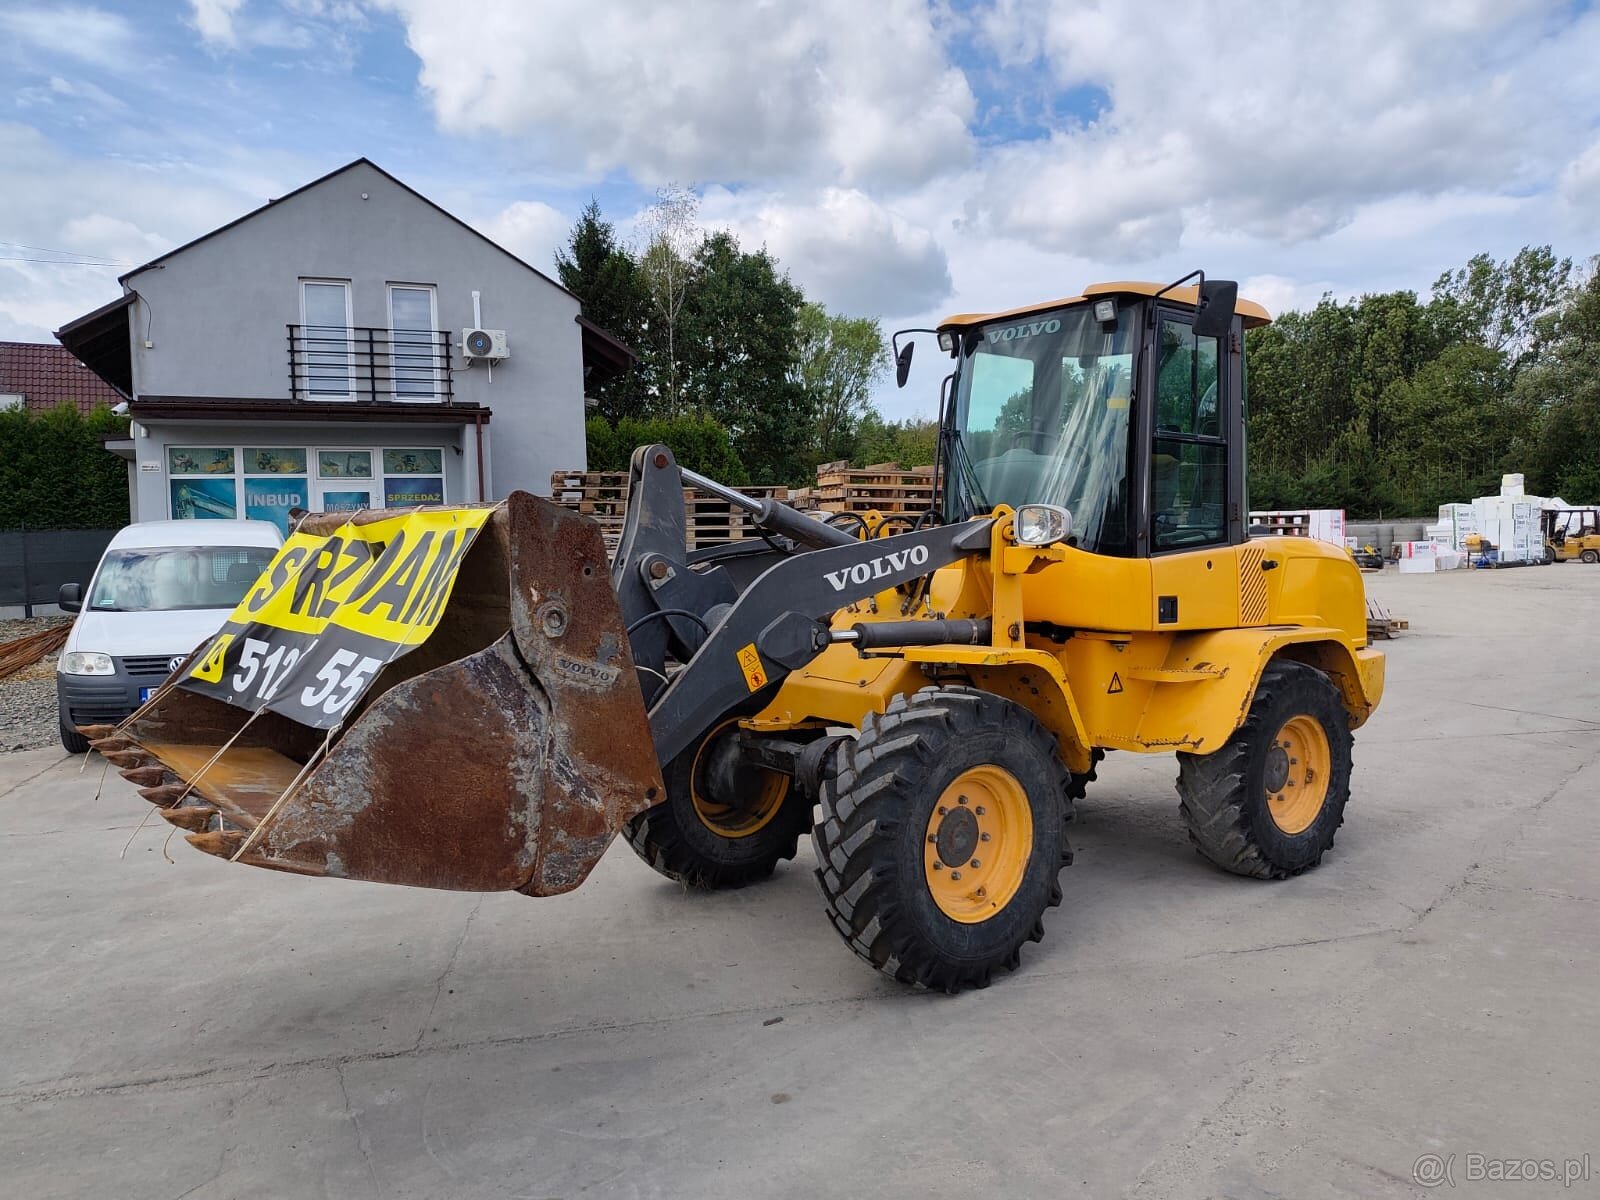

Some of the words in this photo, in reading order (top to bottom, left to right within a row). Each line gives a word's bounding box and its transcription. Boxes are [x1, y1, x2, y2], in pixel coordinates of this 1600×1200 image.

[987, 319, 1061, 344] VOLVO
[247, 493, 301, 507] INBUD
[823, 544, 929, 592] VOLVO
[559, 659, 609, 681] VOLVO
